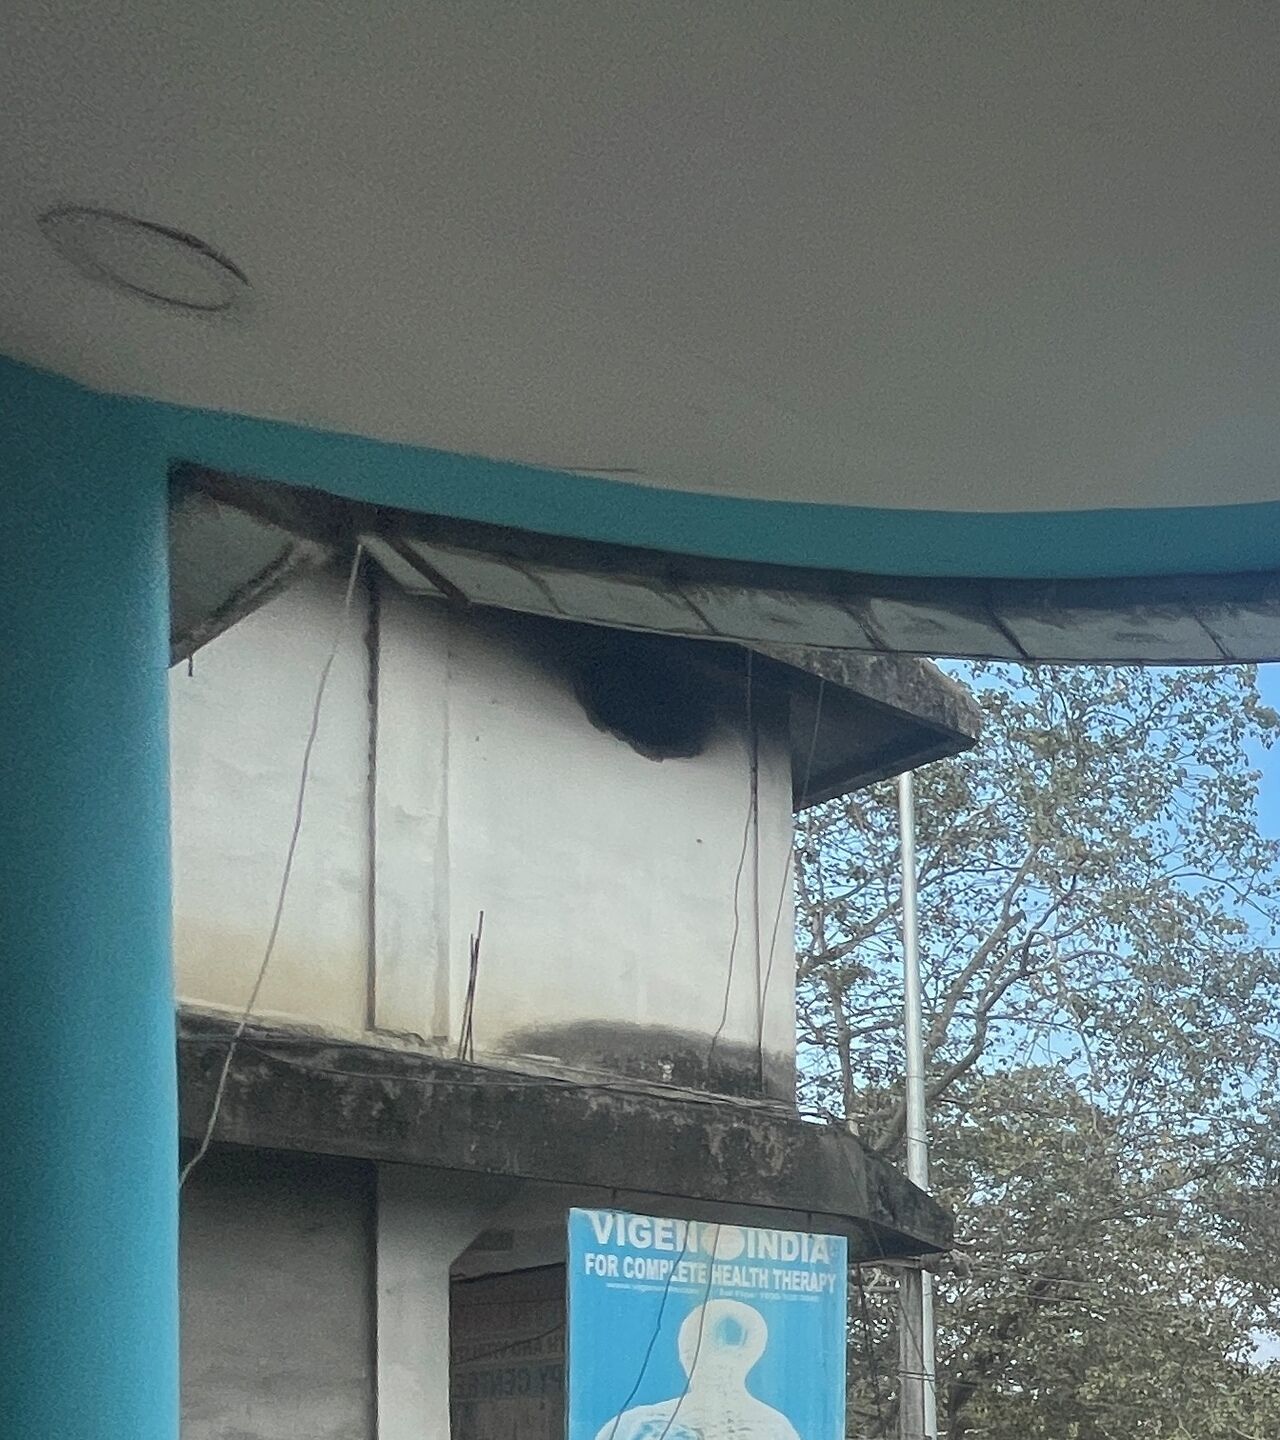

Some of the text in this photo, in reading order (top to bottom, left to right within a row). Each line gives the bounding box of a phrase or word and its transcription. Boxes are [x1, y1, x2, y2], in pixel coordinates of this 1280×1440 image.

[585, 1211, 830, 1264] VIGEN INDIA
[584, 1253, 619, 1277] FOR
[623, 1256, 708, 1284] COMPLETE
[711, 1262, 769, 1289] HEALTH
[772, 1268, 837, 1294] THERAPY
